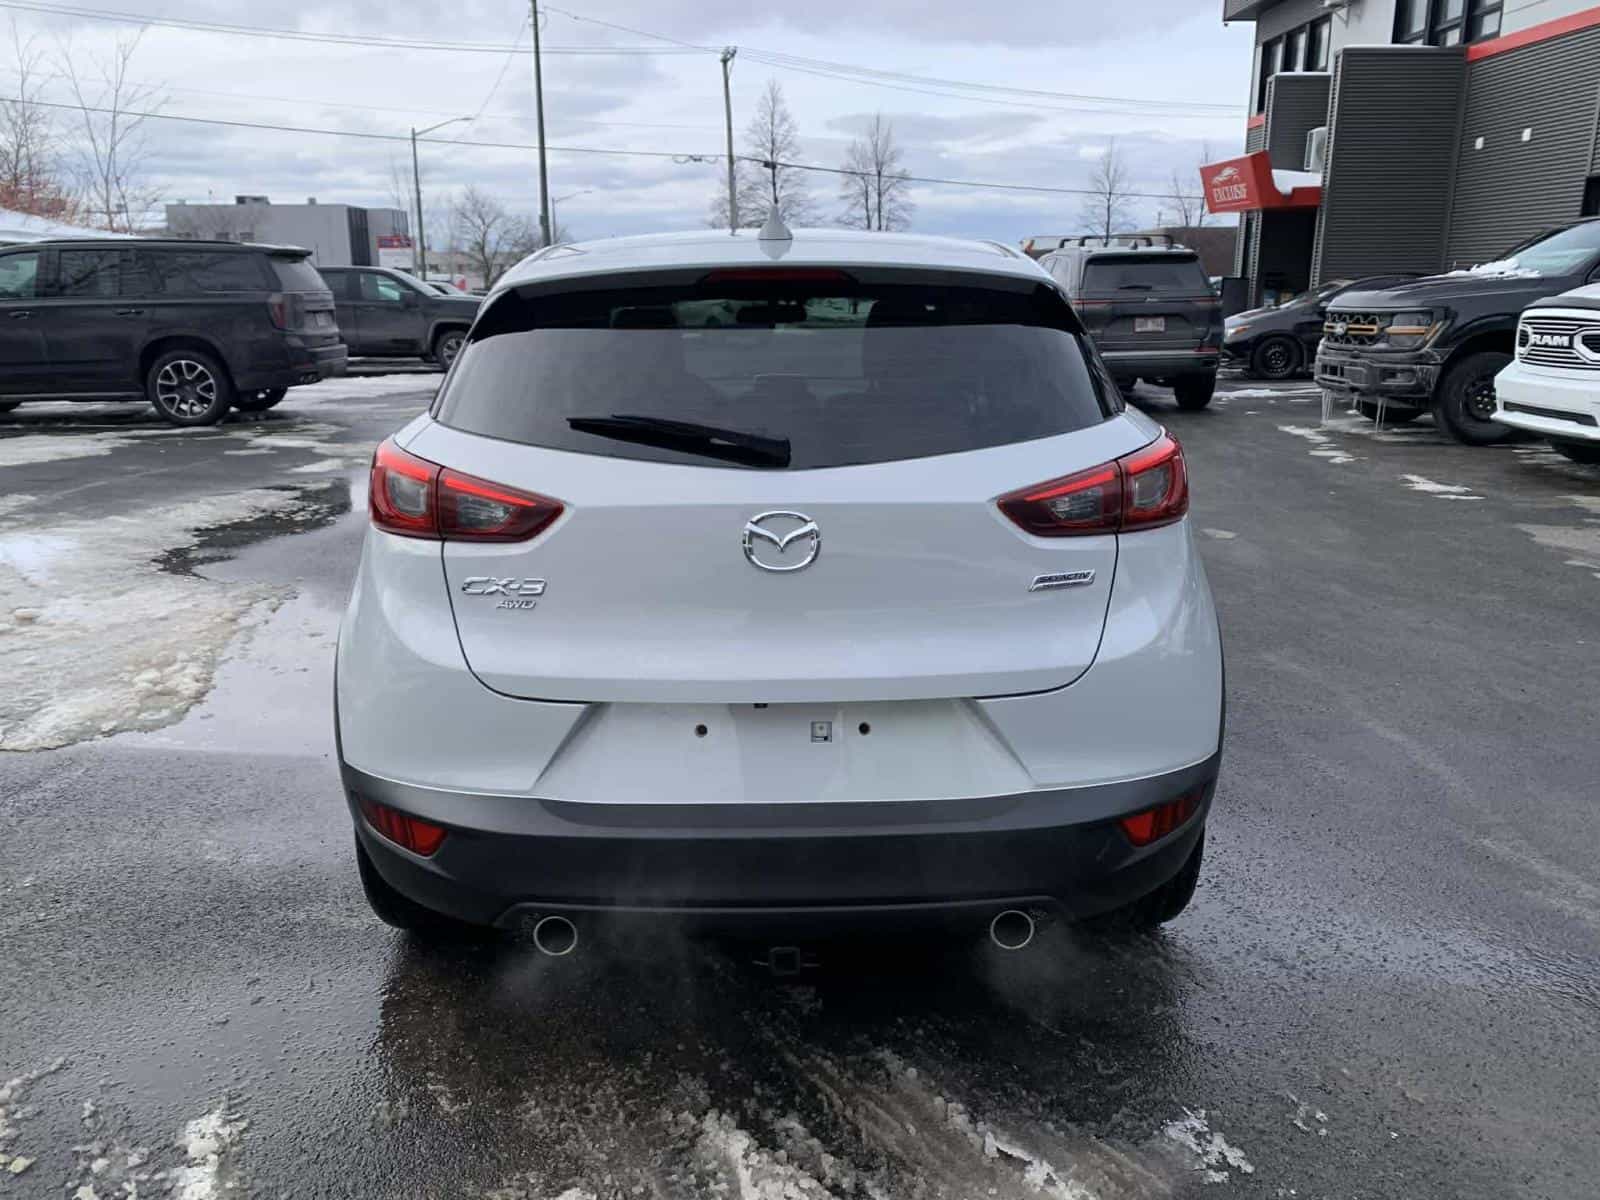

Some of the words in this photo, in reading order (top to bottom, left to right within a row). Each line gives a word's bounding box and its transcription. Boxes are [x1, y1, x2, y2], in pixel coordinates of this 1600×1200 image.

[1531, 334, 1570, 347] RAM
[462, 576, 547, 596] CX-3
[496, 600, 536, 609] AWD
